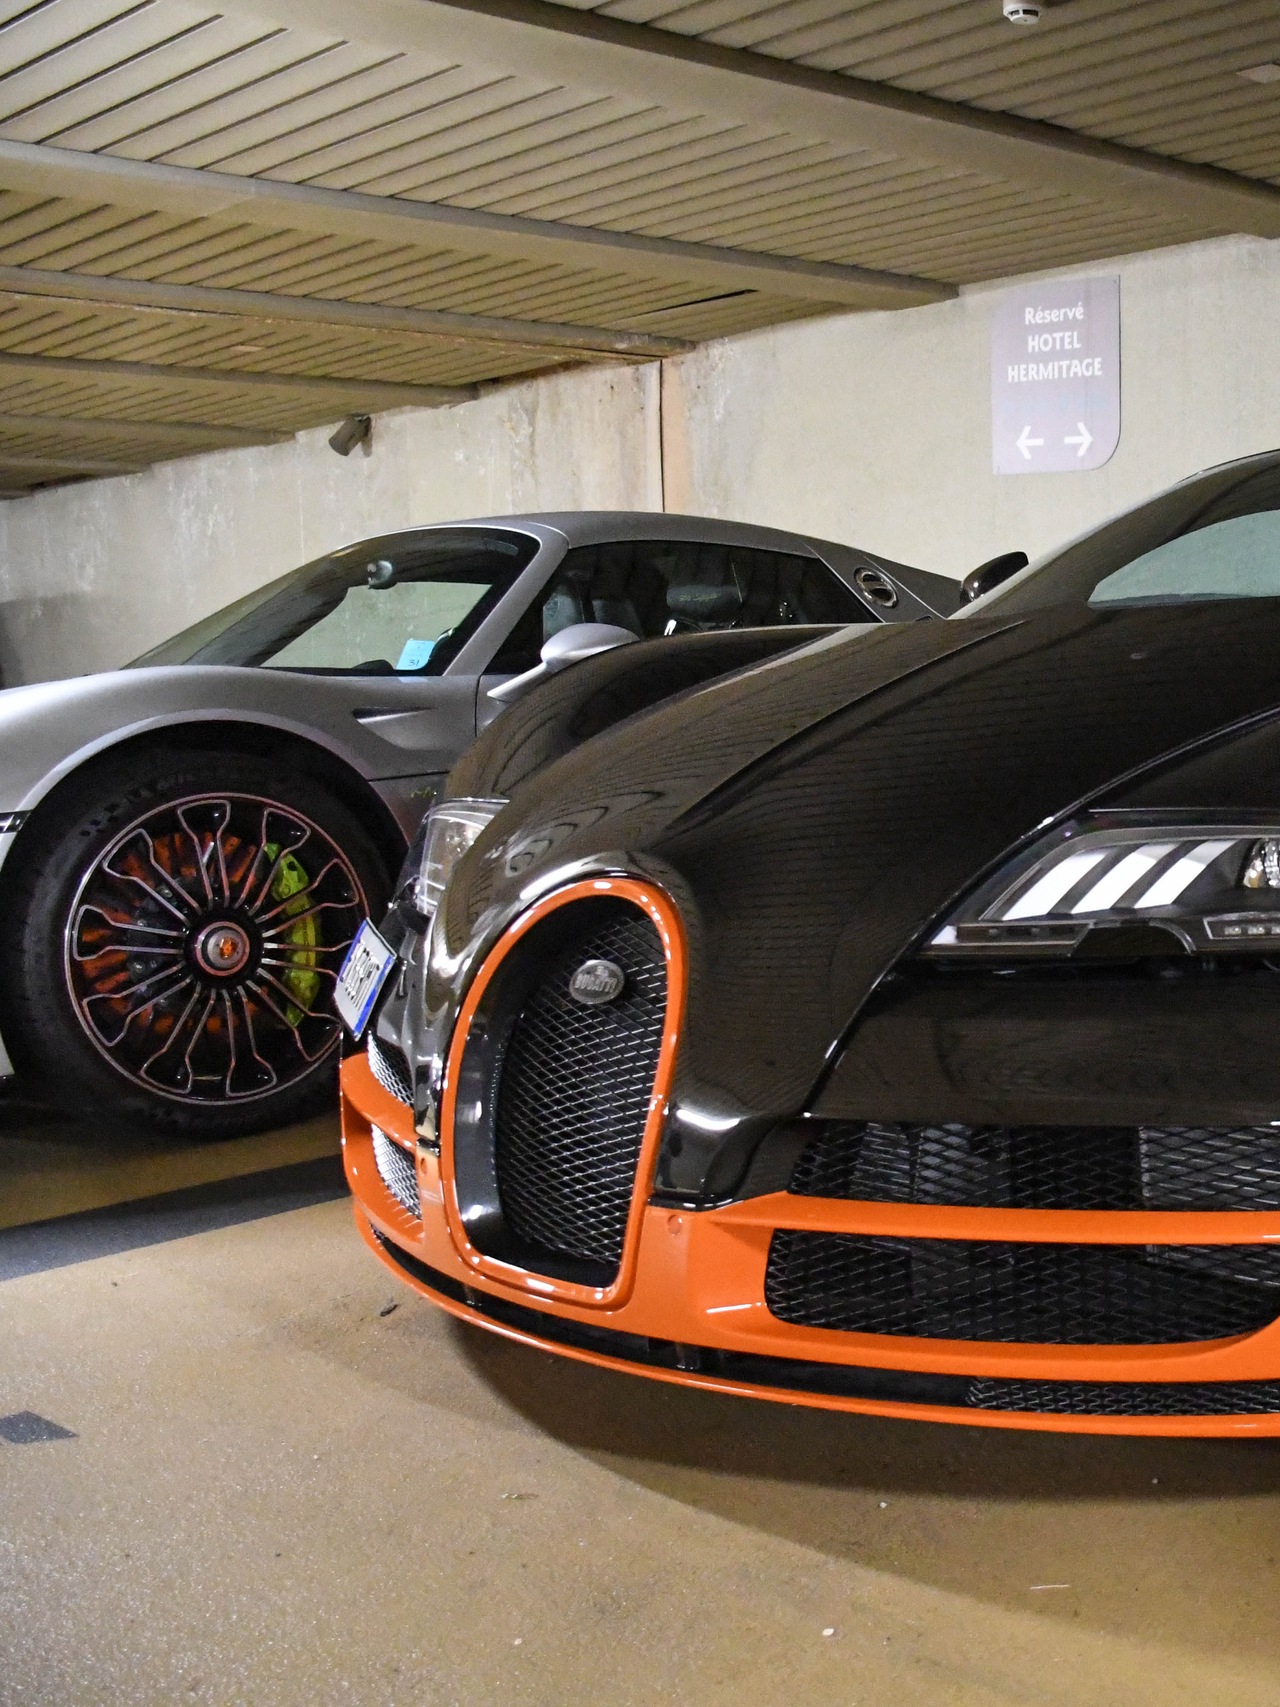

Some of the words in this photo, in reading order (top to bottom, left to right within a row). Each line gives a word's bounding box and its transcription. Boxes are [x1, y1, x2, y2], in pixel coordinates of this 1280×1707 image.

[1025, 302, 1084, 325] Réservé
[1028, 331, 1081, 353] HOTEL
[1008, 357, 1102, 383] HERMITAGE
[574, 973, 618, 992] BUGATTI
